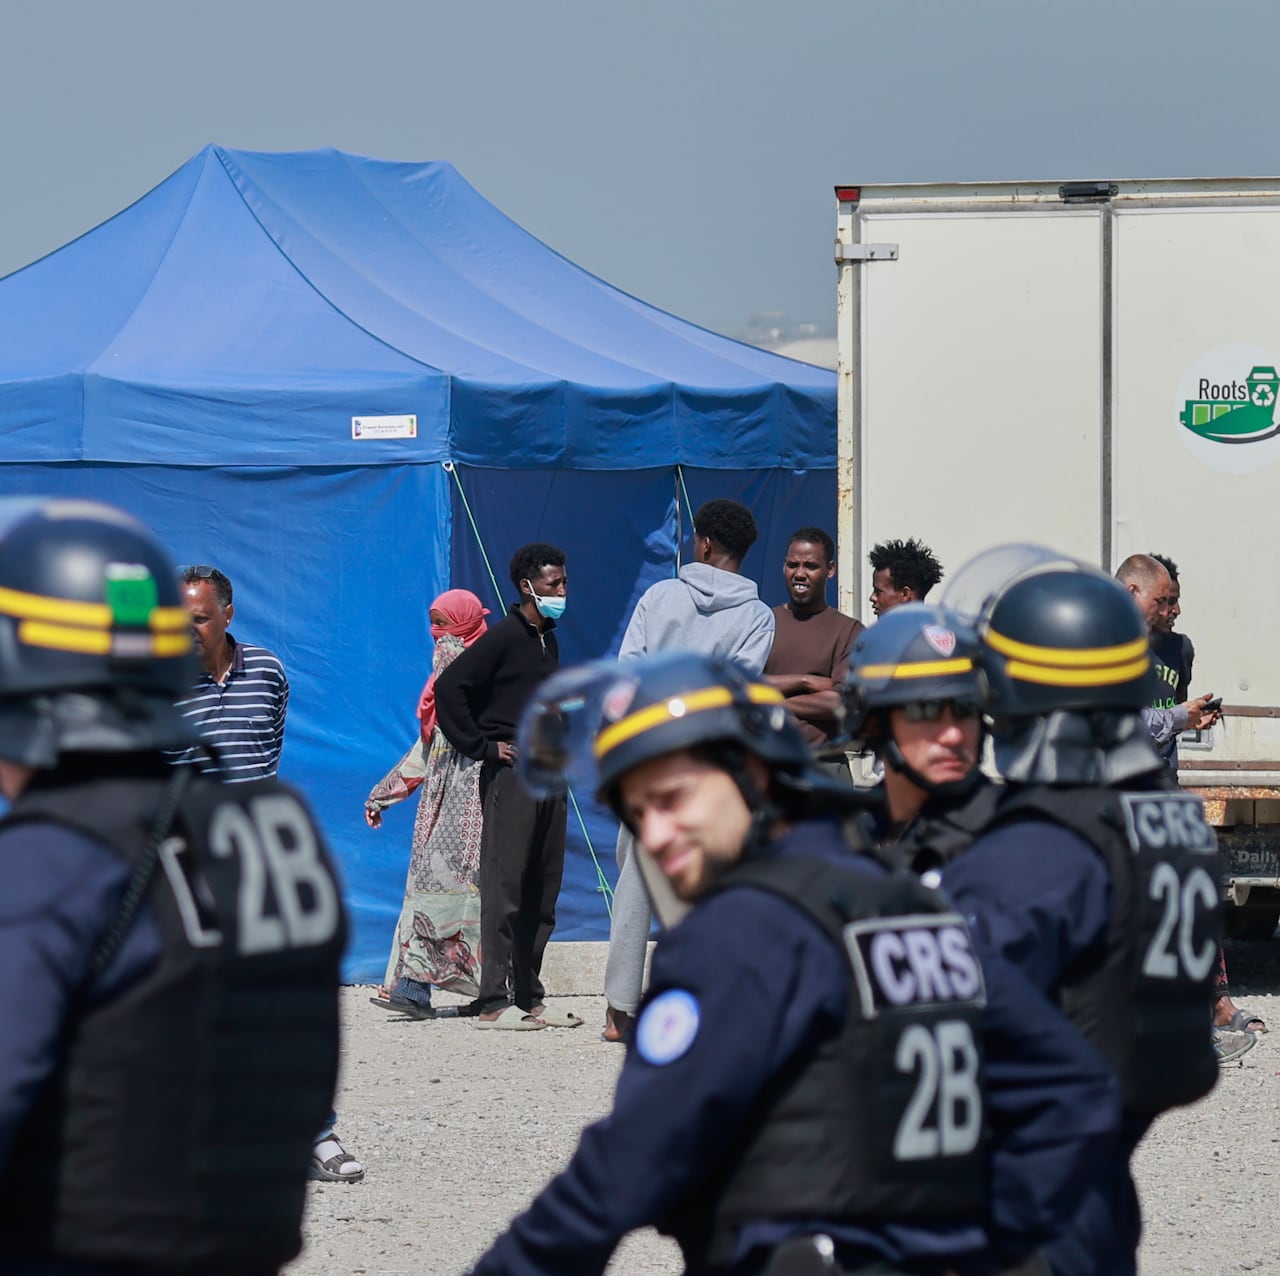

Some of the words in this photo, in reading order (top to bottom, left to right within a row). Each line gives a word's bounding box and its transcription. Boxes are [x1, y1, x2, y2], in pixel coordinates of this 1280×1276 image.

[1199, 378, 1247, 400] Roots
[1136, 801, 1208, 847] CRS
[210, 796, 338, 954] 2B
[1143, 862, 1219, 981] 2C
[871, 927, 979, 1004] CRS
[894, 1020, 982, 1161] 2B
